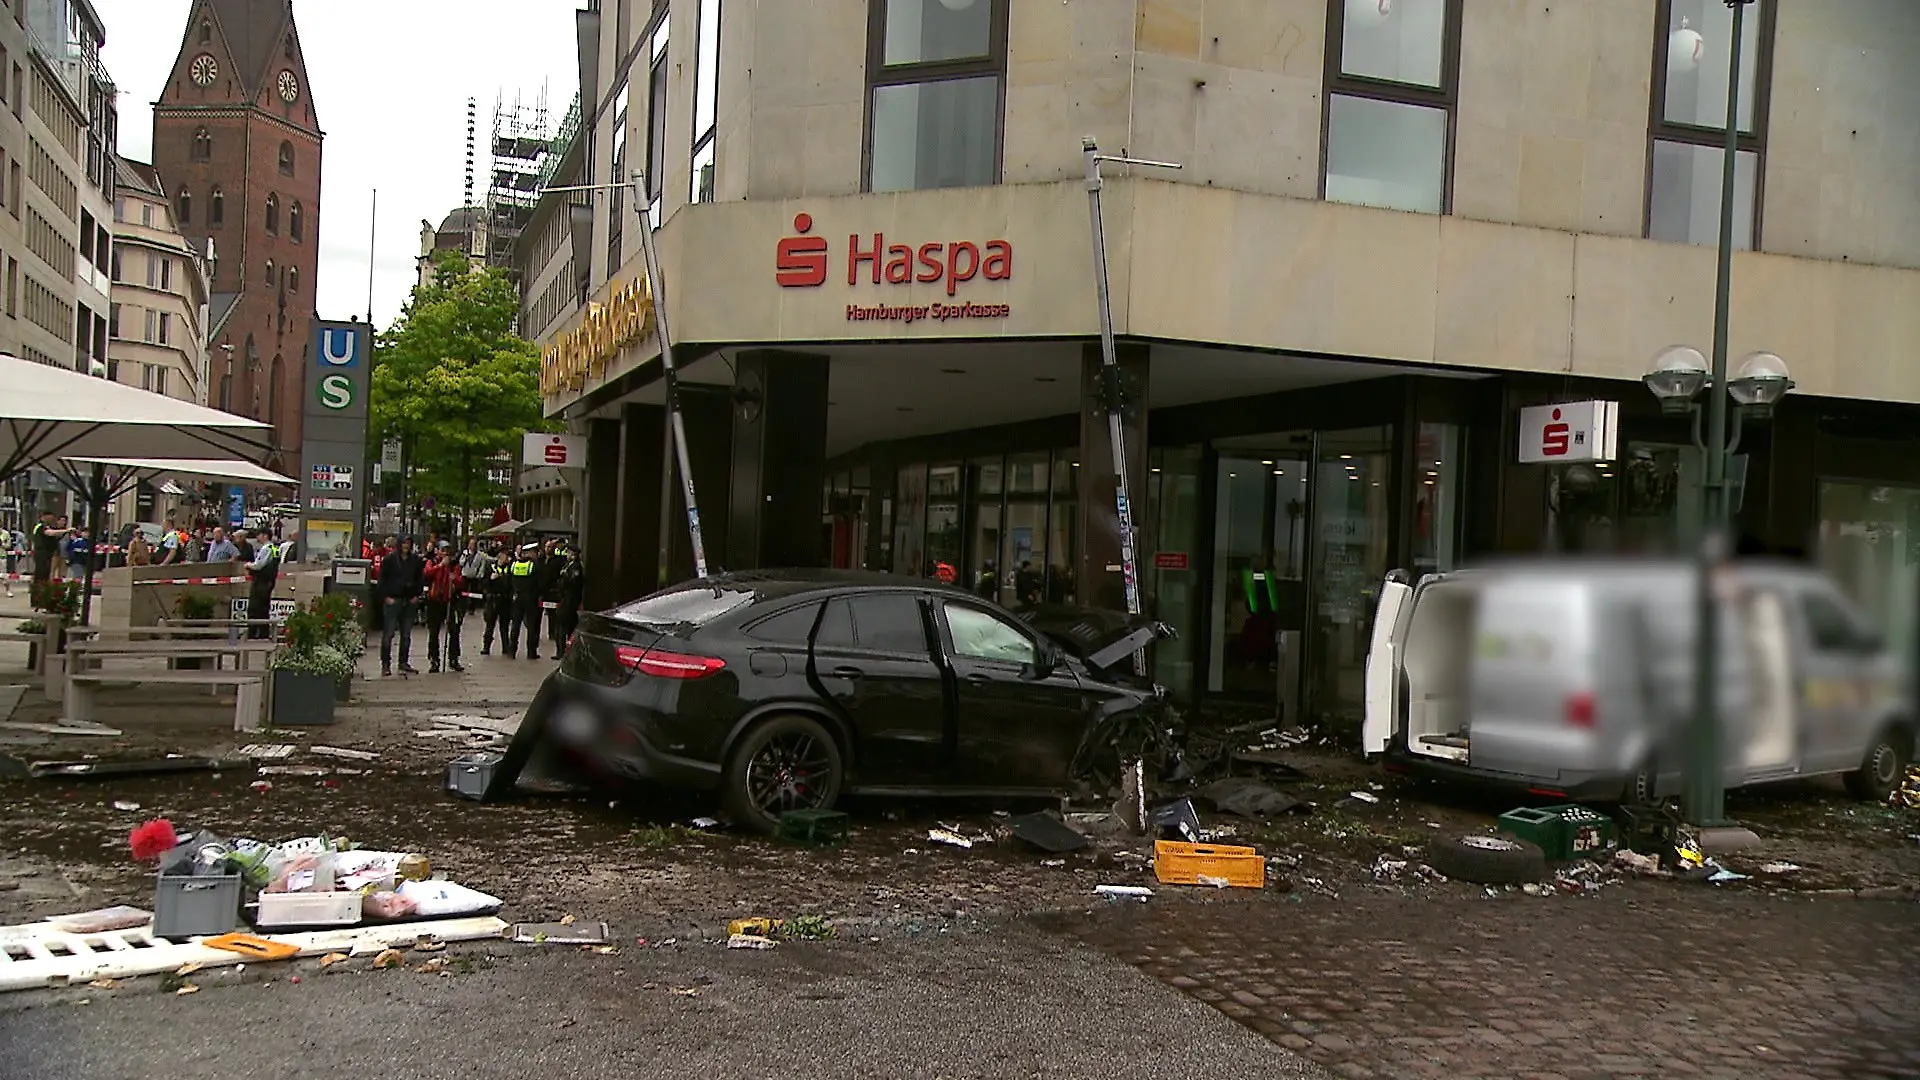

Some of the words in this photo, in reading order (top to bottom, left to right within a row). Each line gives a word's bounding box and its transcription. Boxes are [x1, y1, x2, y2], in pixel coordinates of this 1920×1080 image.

[847, 232, 1012, 296] Haspa
[846, 303, 930, 324] Hamburger
[931, 301, 1010, 322] Sparkasse
[323, 329, 355, 366] U
[321, 374, 351, 409] S
